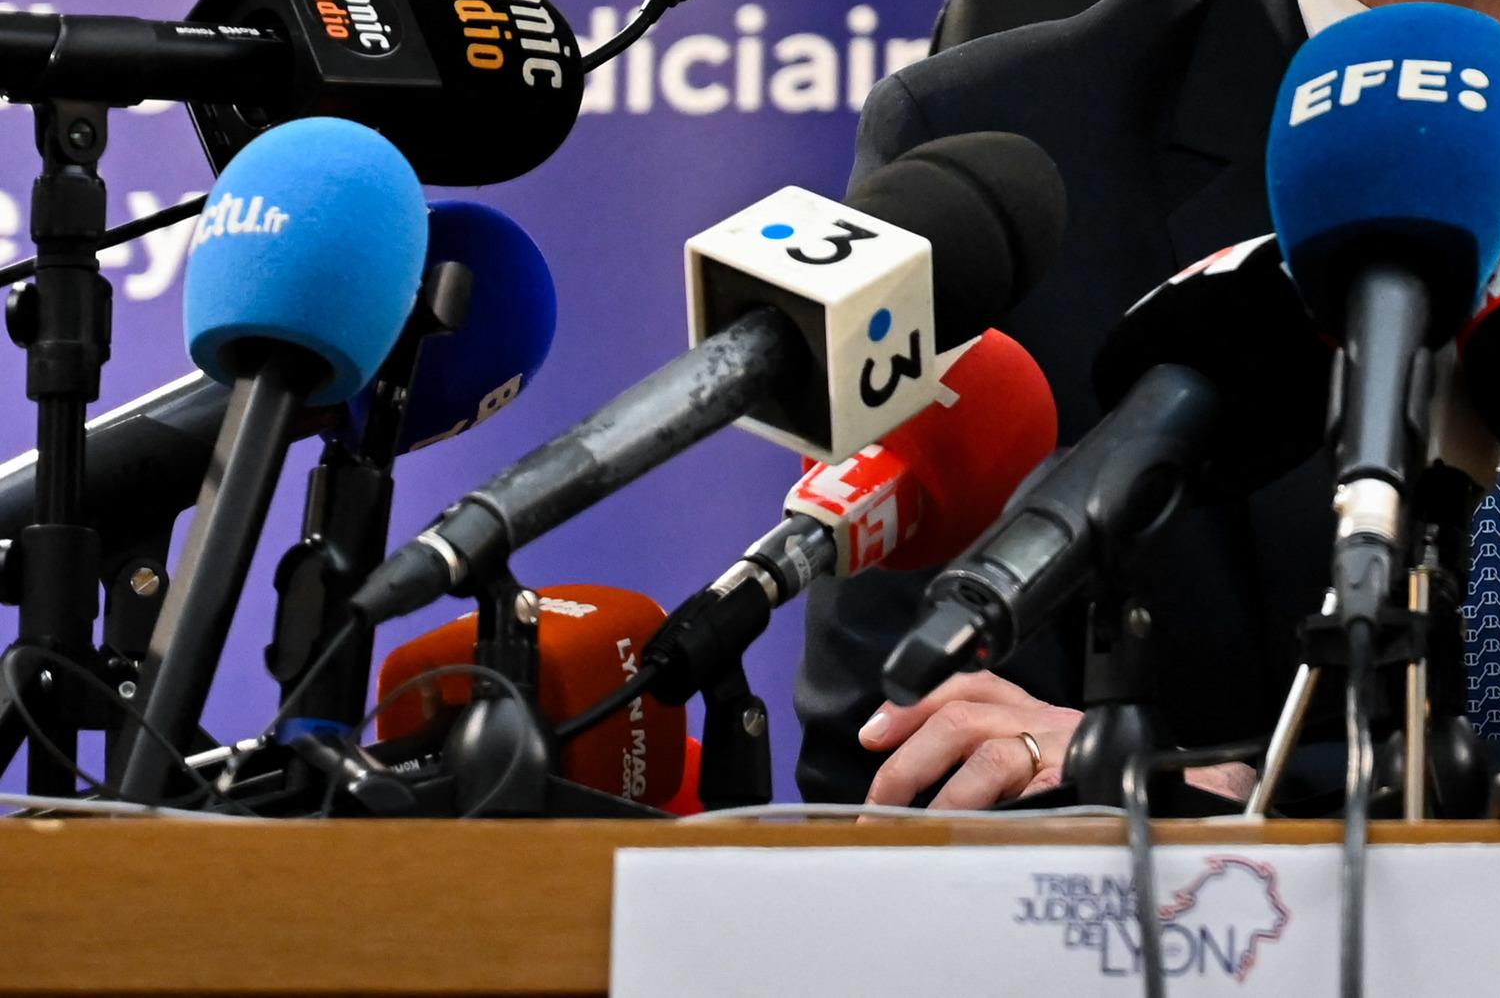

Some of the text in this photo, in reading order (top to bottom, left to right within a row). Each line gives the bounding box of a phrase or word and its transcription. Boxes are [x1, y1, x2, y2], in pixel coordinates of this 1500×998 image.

[786, 219, 879, 265] 3
[860, 328, 922, 408] 3
[616, 637, 647, 797] LYN MAG
